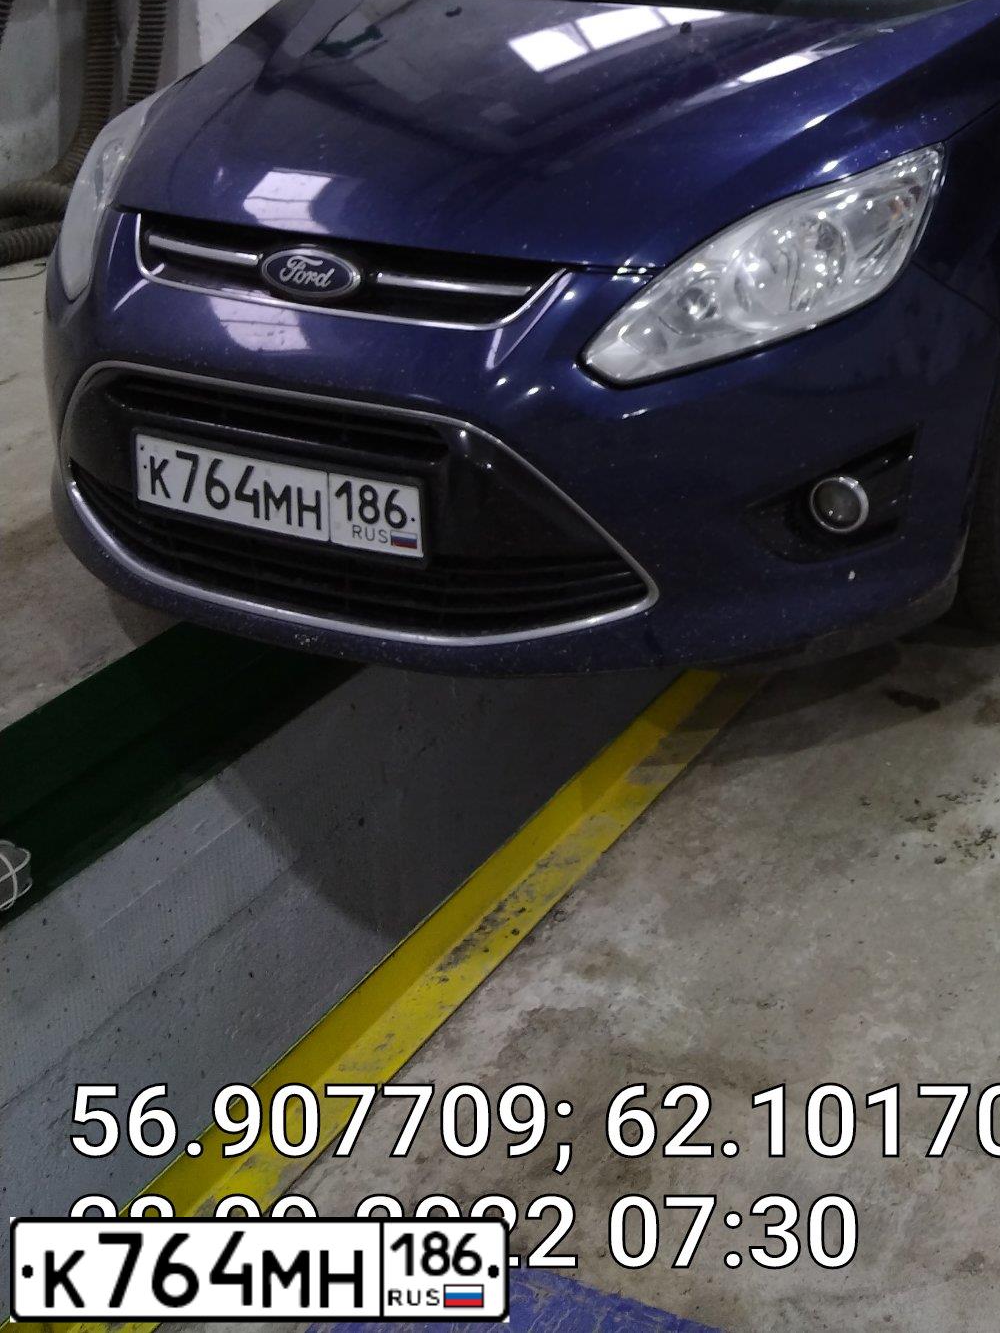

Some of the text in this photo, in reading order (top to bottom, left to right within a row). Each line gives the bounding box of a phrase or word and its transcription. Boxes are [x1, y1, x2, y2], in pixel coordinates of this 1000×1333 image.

[280, 255, 335, 289] Ford
[334, 480, 407, 529] 186
[352, 524, 388, 544] RUS
